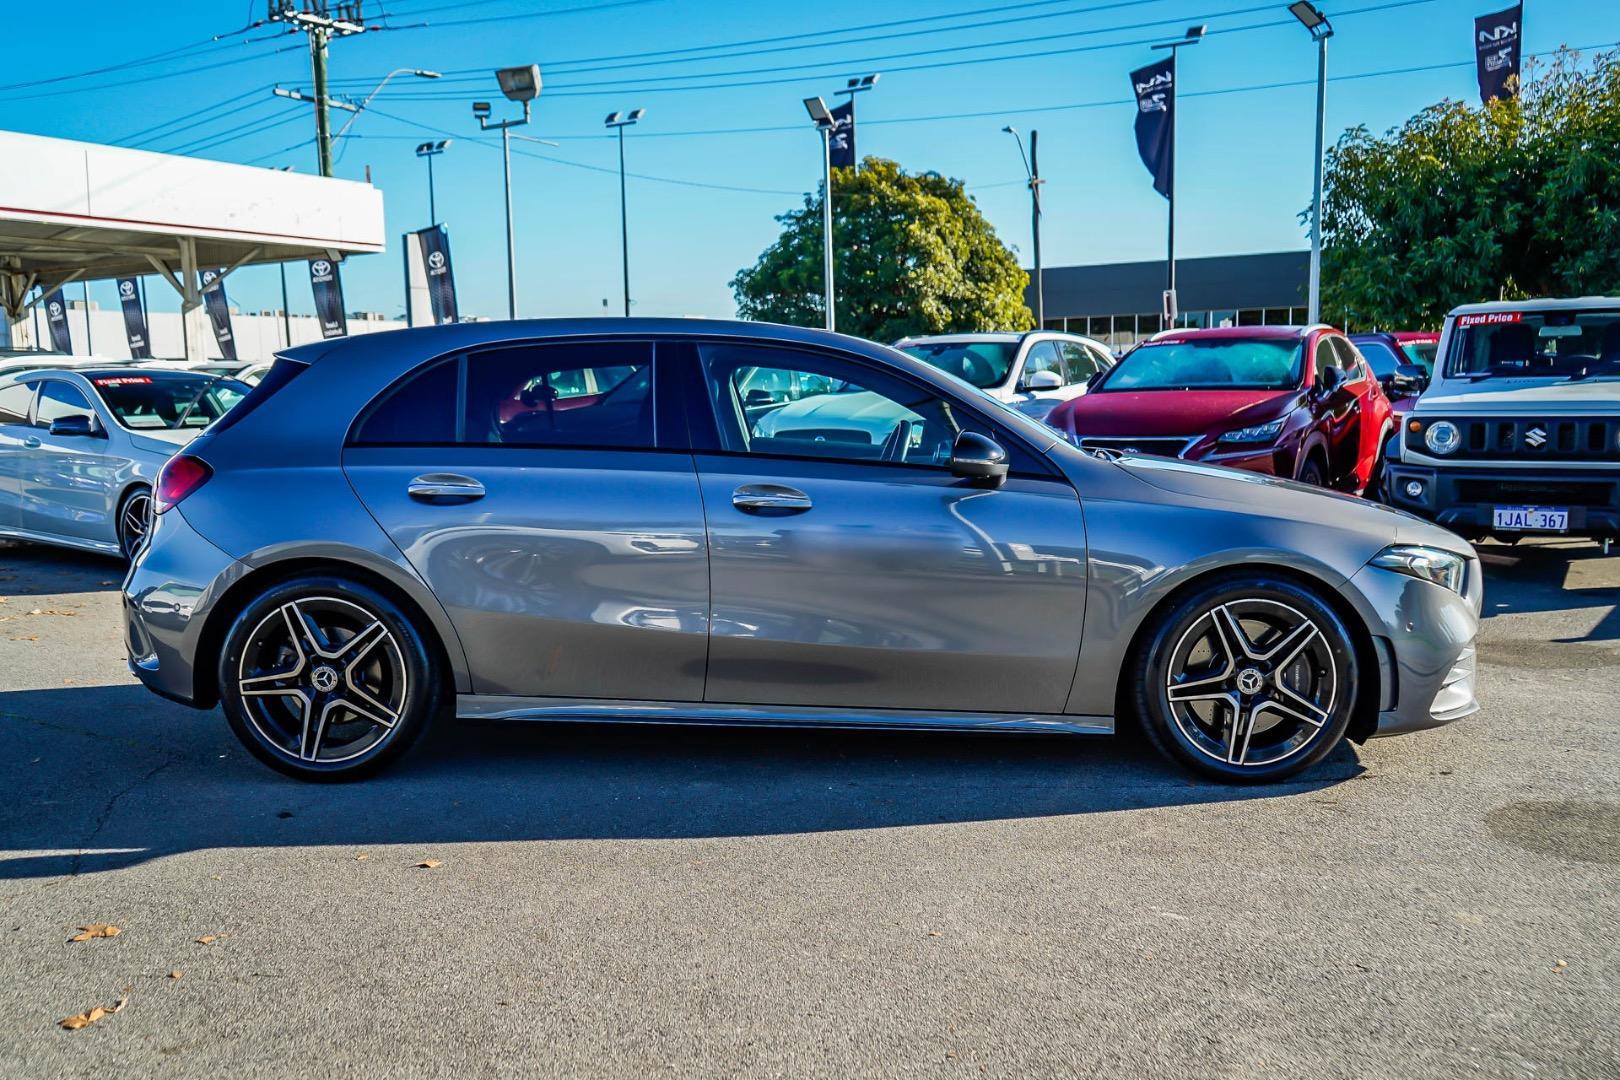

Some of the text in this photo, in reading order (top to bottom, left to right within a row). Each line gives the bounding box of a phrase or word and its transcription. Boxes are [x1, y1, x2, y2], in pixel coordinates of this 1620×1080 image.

[1461, 313, 1513, 325] Fixed Price
[1540, 513, 1565, 528] 367
